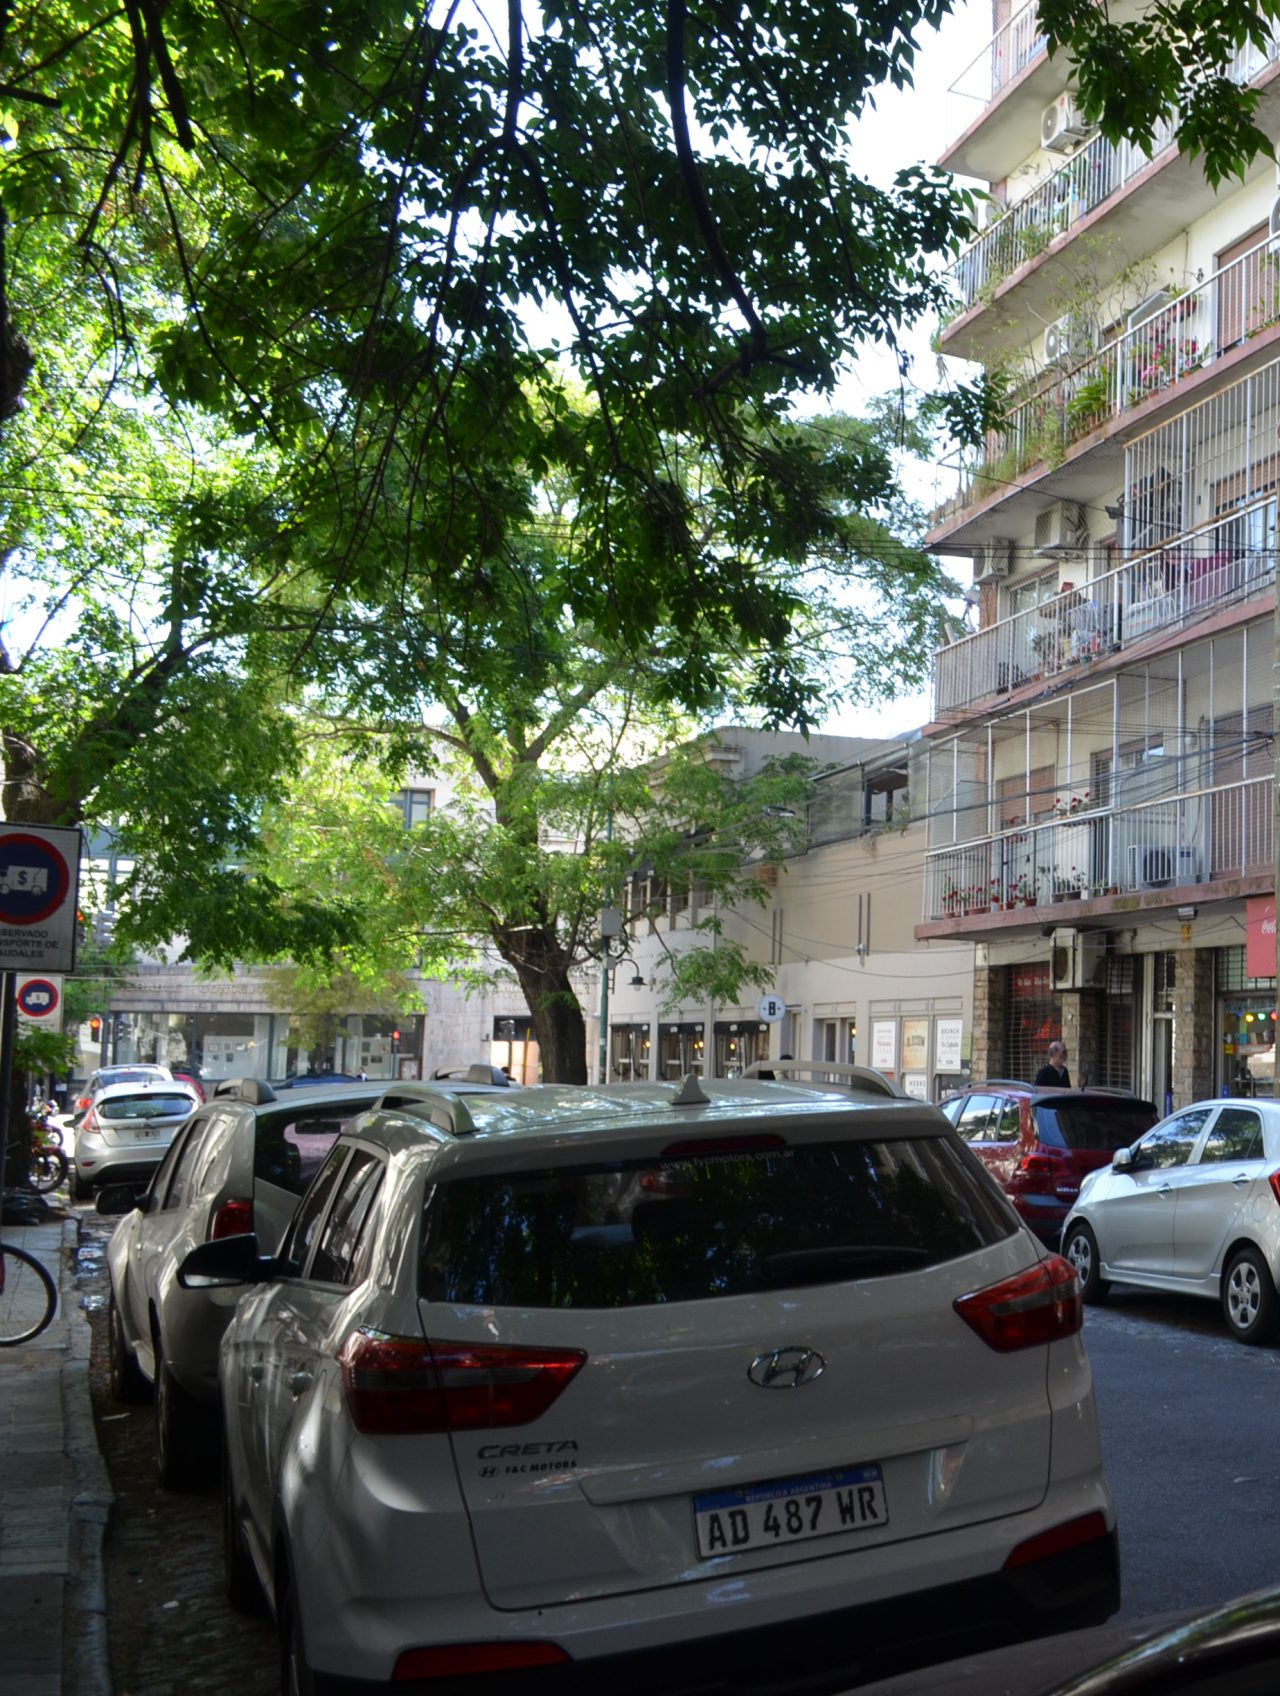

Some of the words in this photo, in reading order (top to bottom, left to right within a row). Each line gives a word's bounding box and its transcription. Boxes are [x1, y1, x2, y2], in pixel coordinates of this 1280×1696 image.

[0, 928, 49, 938] SERVADO
[477, 1439, 580, 1460] CRETA
[529, 1459, 577, 1473] MOTORS
[790, 1480, 833, 1496] ARGENTINA
[708, 1508, 750, 1551] AD
[763, 1494, 823, 1538] 487
[836, 1486, 879, 1525] WR
